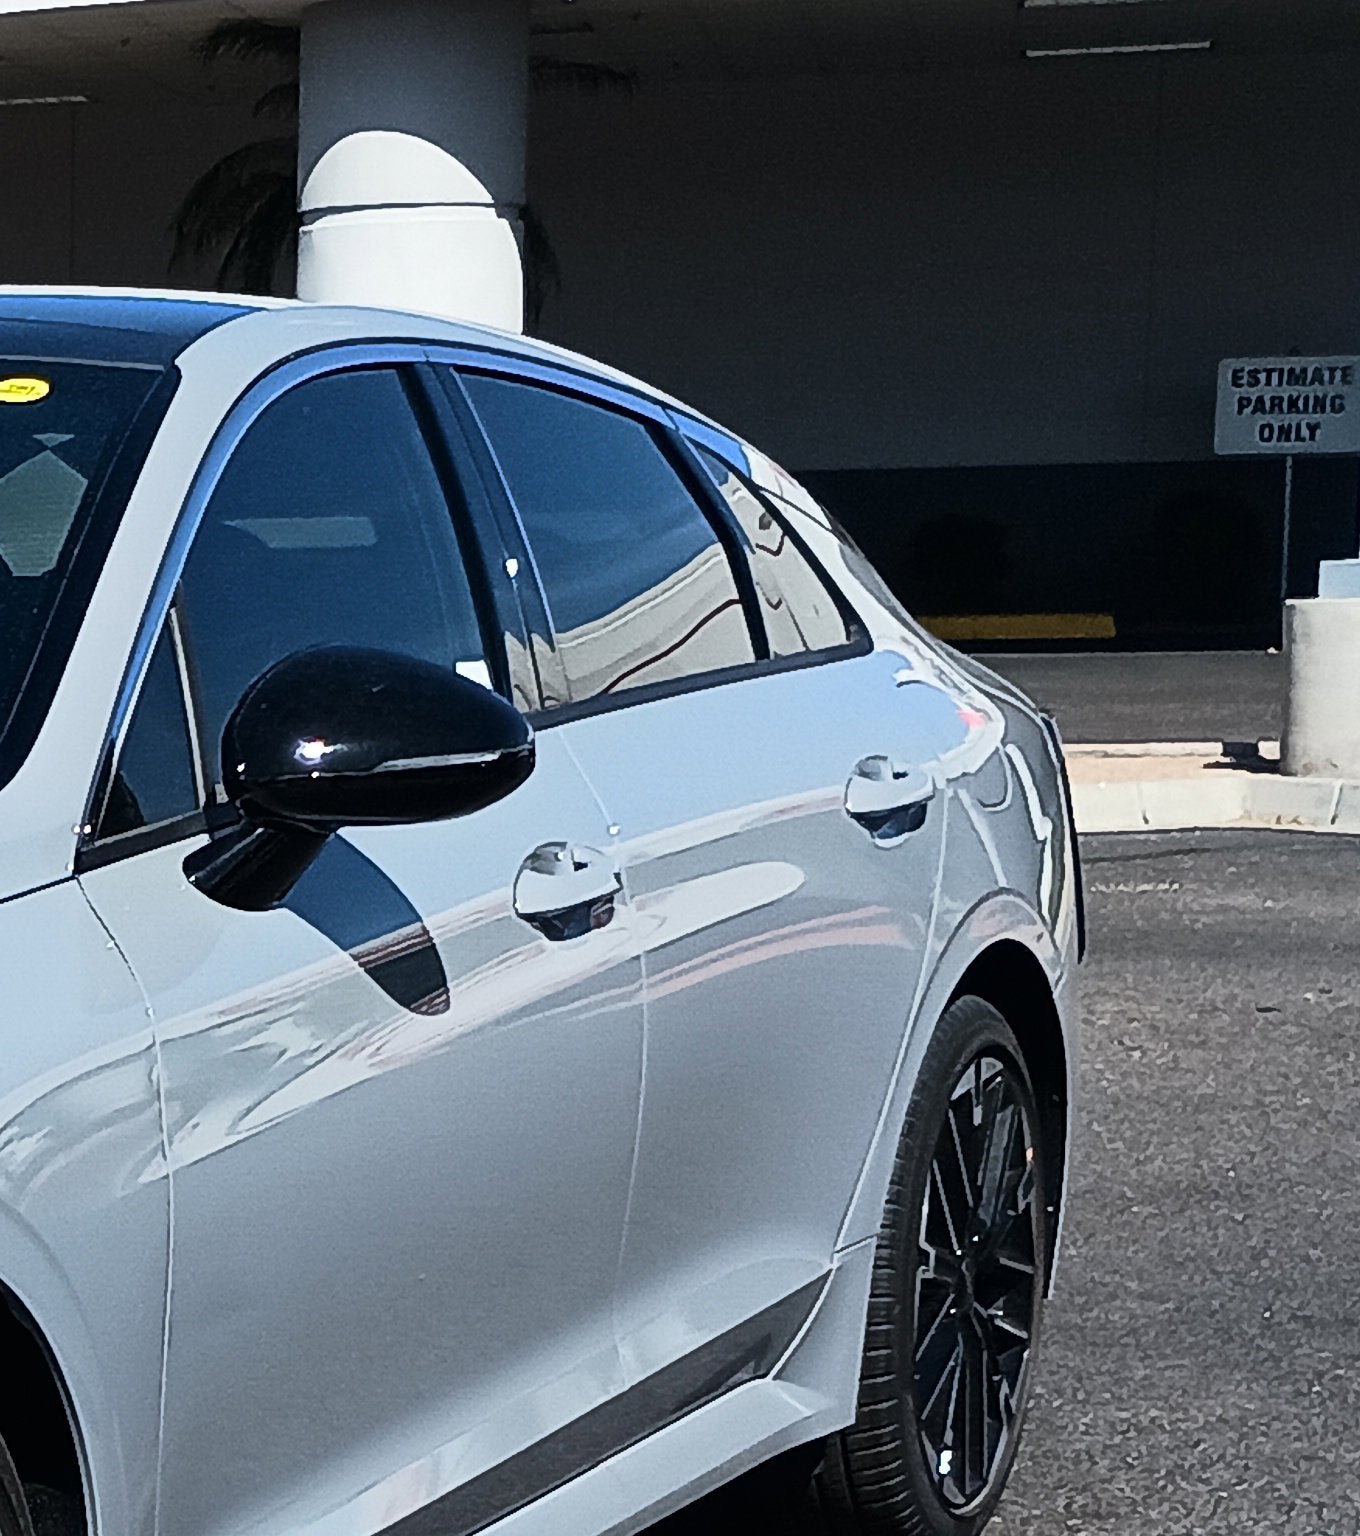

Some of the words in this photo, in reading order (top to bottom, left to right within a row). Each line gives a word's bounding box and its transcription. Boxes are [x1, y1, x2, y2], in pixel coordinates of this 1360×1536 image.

[1231, 365, 1354, 389] ESTIMATE
[1236, 393, 1346, 416] PARKING
[1258, 421, 1322, 443] ONLY
